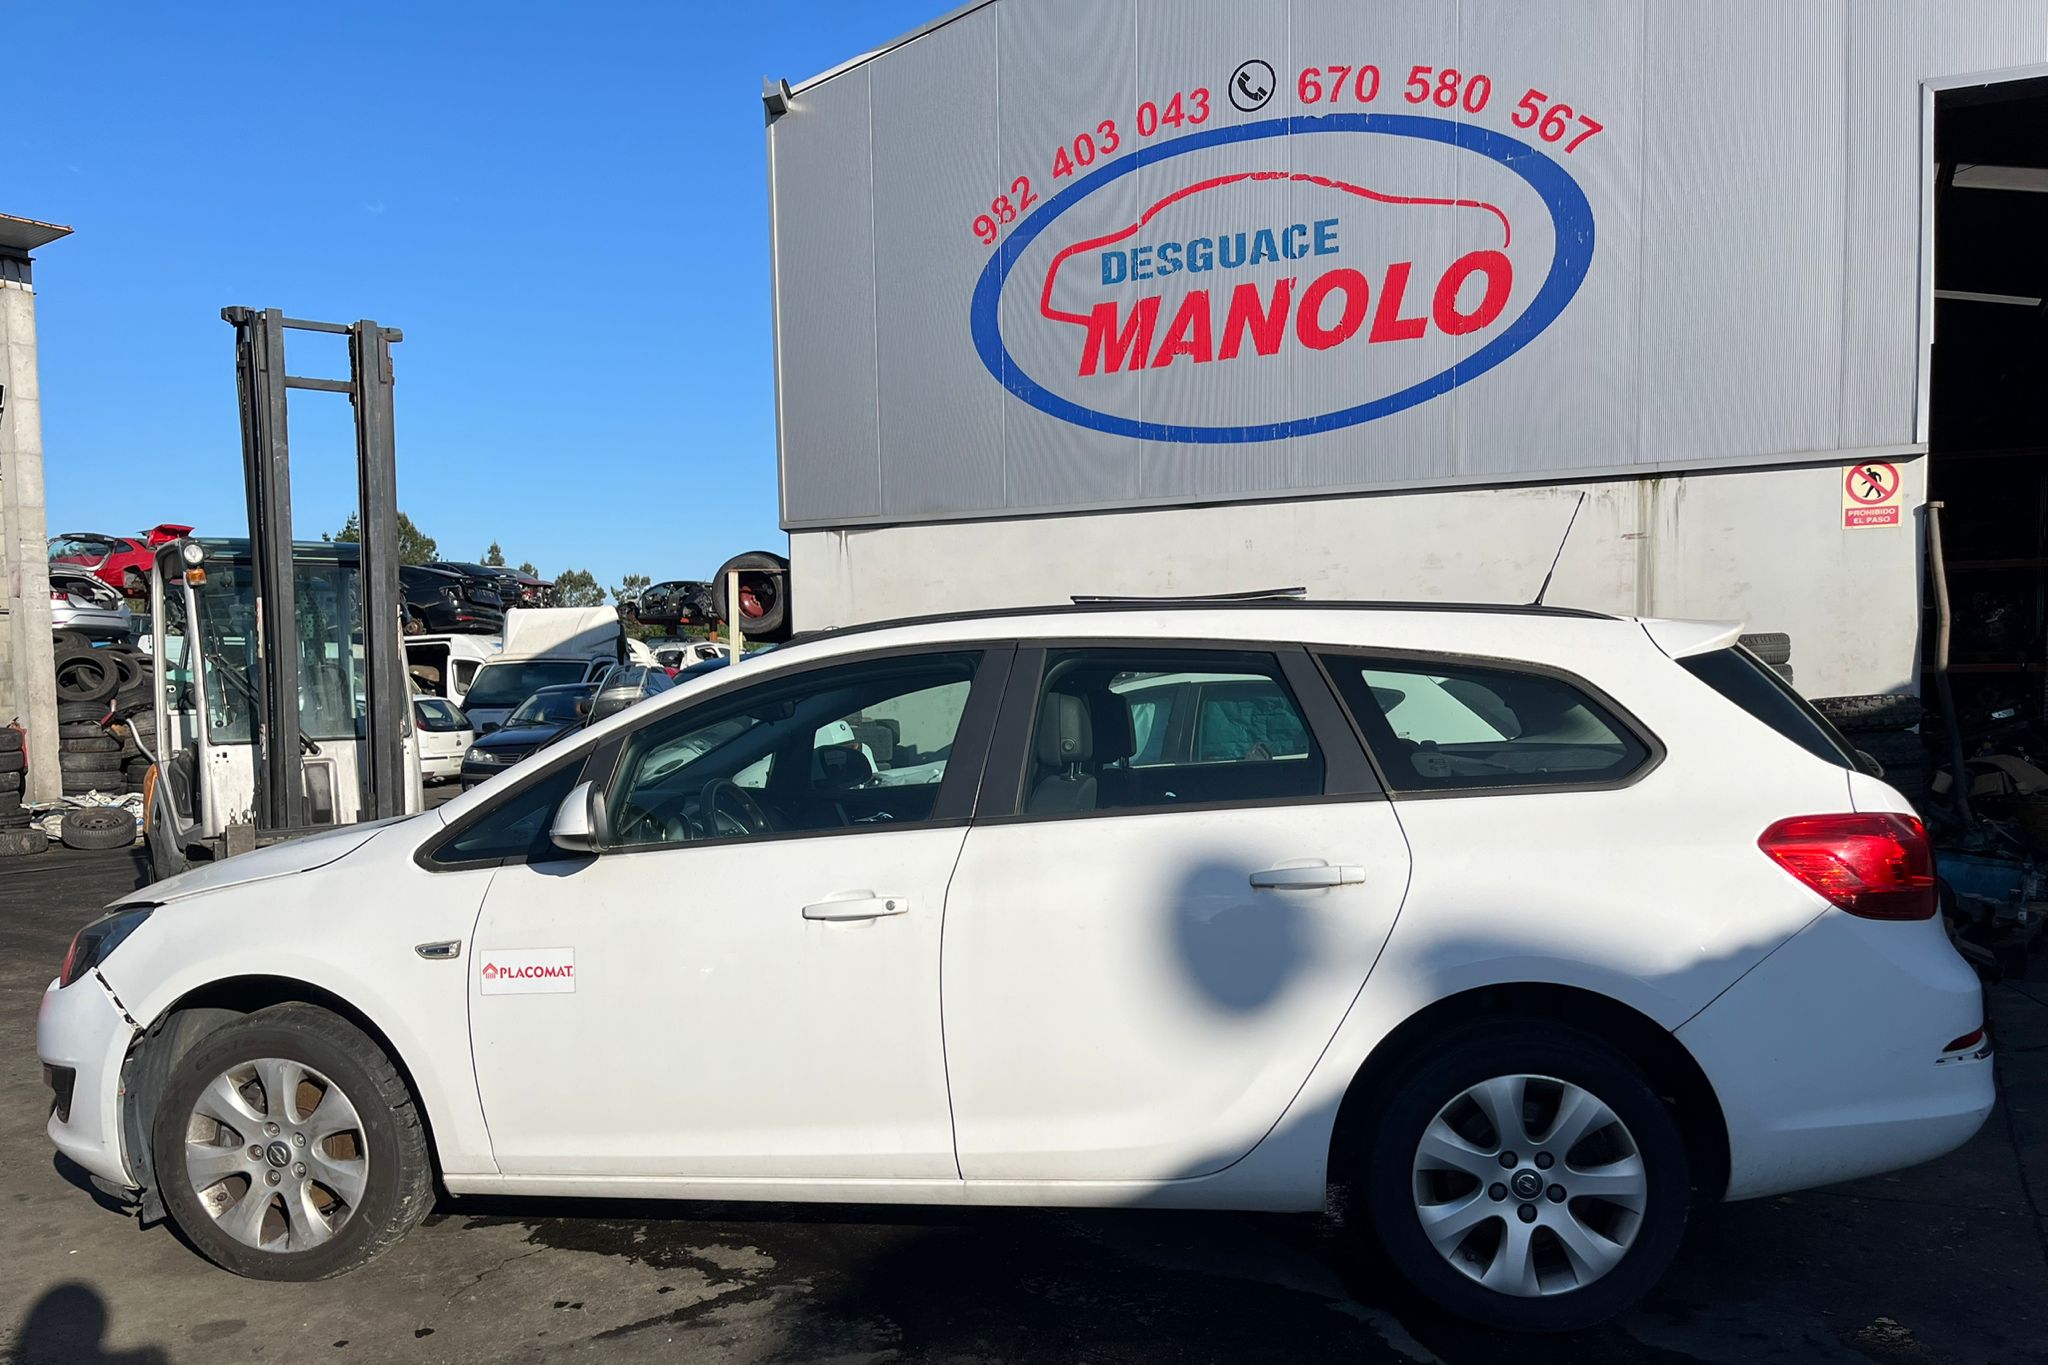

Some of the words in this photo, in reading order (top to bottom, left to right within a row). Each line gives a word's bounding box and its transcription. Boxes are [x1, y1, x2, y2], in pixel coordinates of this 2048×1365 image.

[1297, 64, 1381, 104] 670
[1403, 65, 1492, 114] 580
[1510, 88, 1604, 154] 567
[972, 175, 1039, 246] 982
[1052, 119, 1120, 179] 403
[1136, 87, 1211, 137] 043
[1101, 218, 1340, 286] DESGUACE
[1078, 250, 1513, 377] MANOLO
[1847, 507, 1896, 517] PROHIBIDO
[1866, 516, 1891, 524] PASO
[500, 965, 573, 979] PLACOMAT
